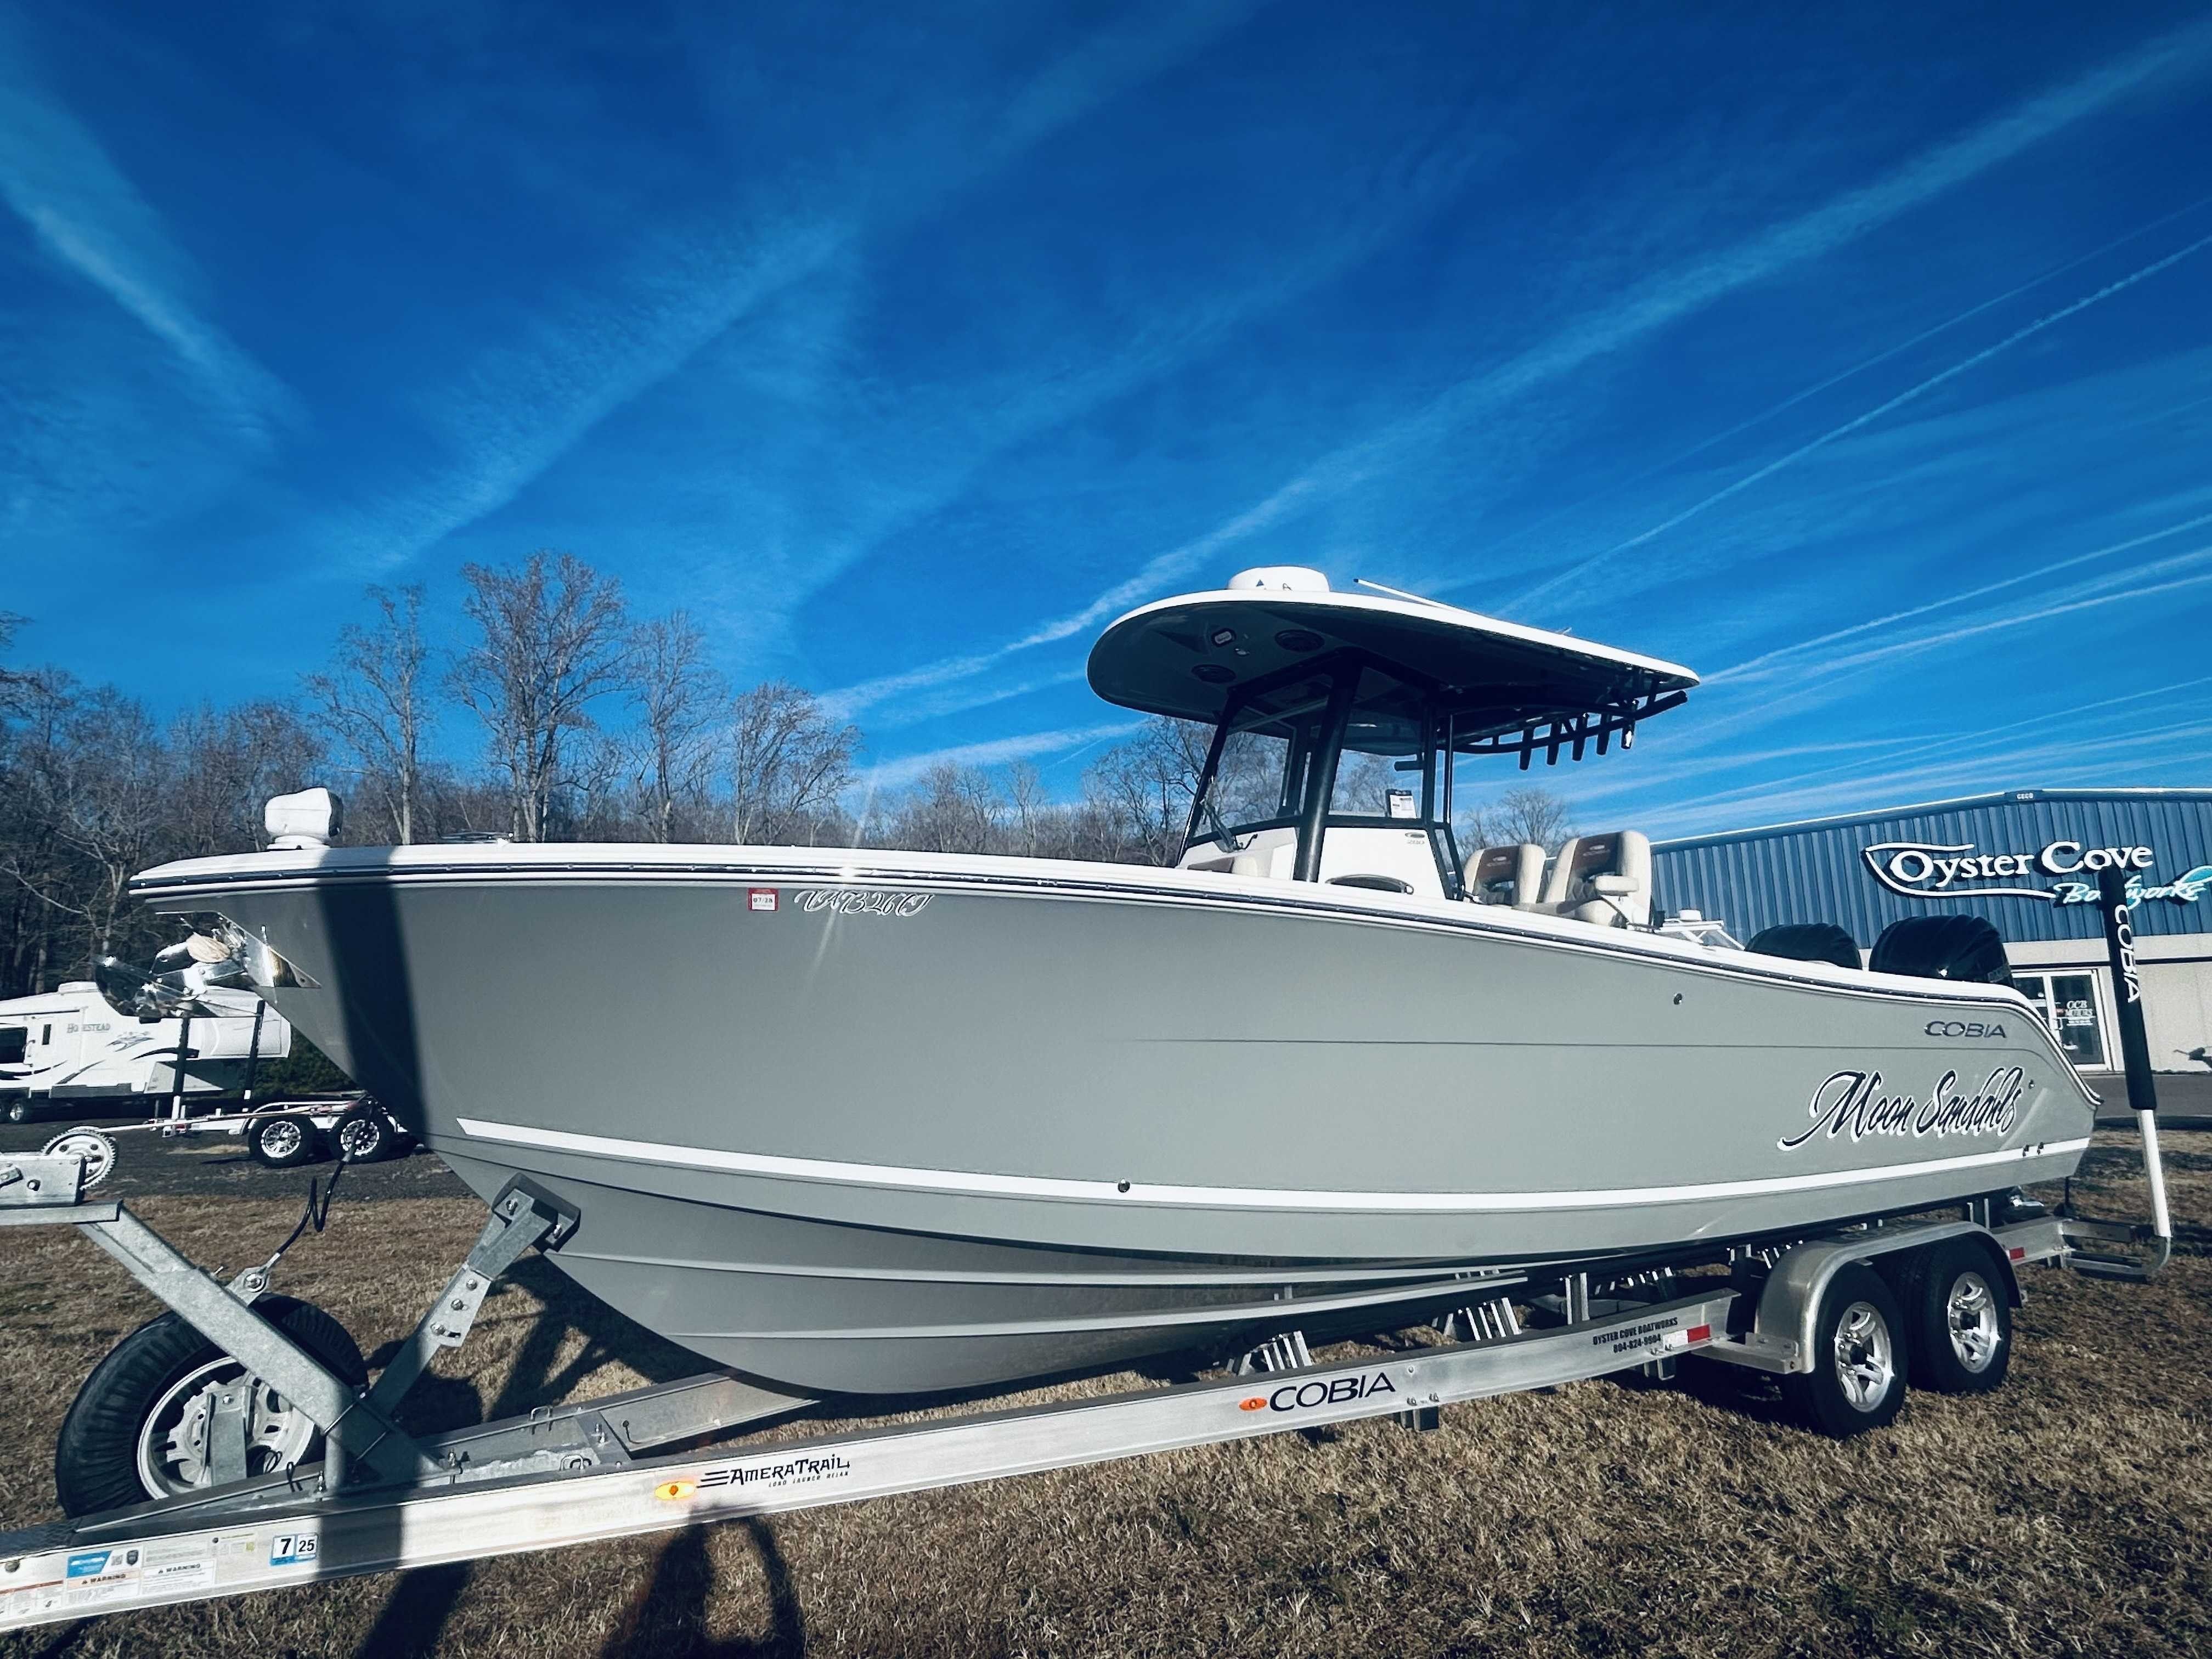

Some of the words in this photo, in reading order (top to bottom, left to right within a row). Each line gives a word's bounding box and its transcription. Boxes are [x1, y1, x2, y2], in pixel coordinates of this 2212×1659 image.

[1889, 850, 2034, 887] Oyster
[2041, 841, 2153, 874] Cove
[2115, 904, 2140, 1003] COBIA
[66, 1023, 111, 1033] HOESTEAD
[1925, 1021, 2007, 1039] COBIA
[1777, 1069, 1915, 1150] Moon
[1593, 1331, 1618, 1345] OYSTER
[1620, 1327, 1637, 1339] COVE
[1638, 1317, 1678, 1334] BOATWORKS
[1269, 1372, 1396, 1412] COBIA
[281, 1538, 291, 1555] 7
[298, 1539, 315, 1553] 25
[91, 1573, 126, 1582] WARNING
[166, 1563, 201, 1572] WARNING
